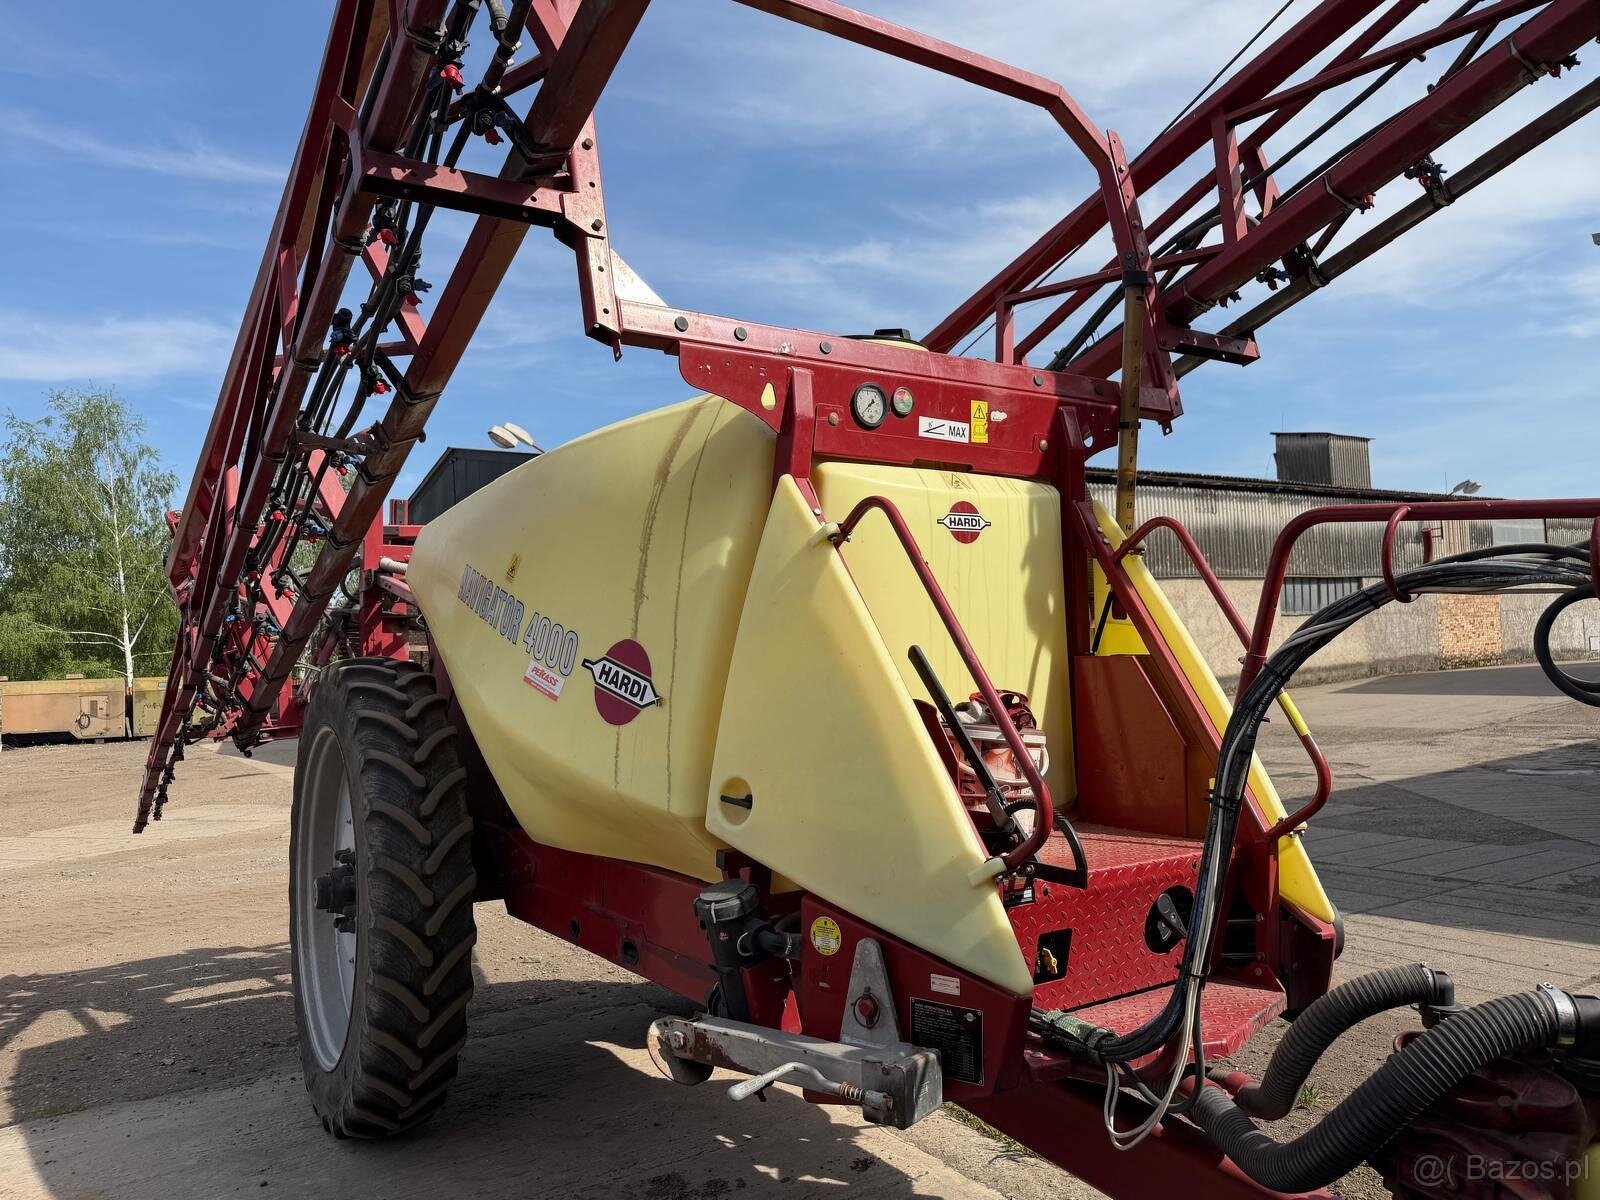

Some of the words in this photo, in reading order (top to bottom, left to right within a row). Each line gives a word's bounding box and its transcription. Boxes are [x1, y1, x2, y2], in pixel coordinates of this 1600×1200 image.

[948, 425, 967, 439] MAX
[949, 517, 981, 528] HARDI
[457, 563, 525, 645] NAVIGATOR
[523, 611, 579, 677] 4000
[599, 663, 648, 702] HARDI
